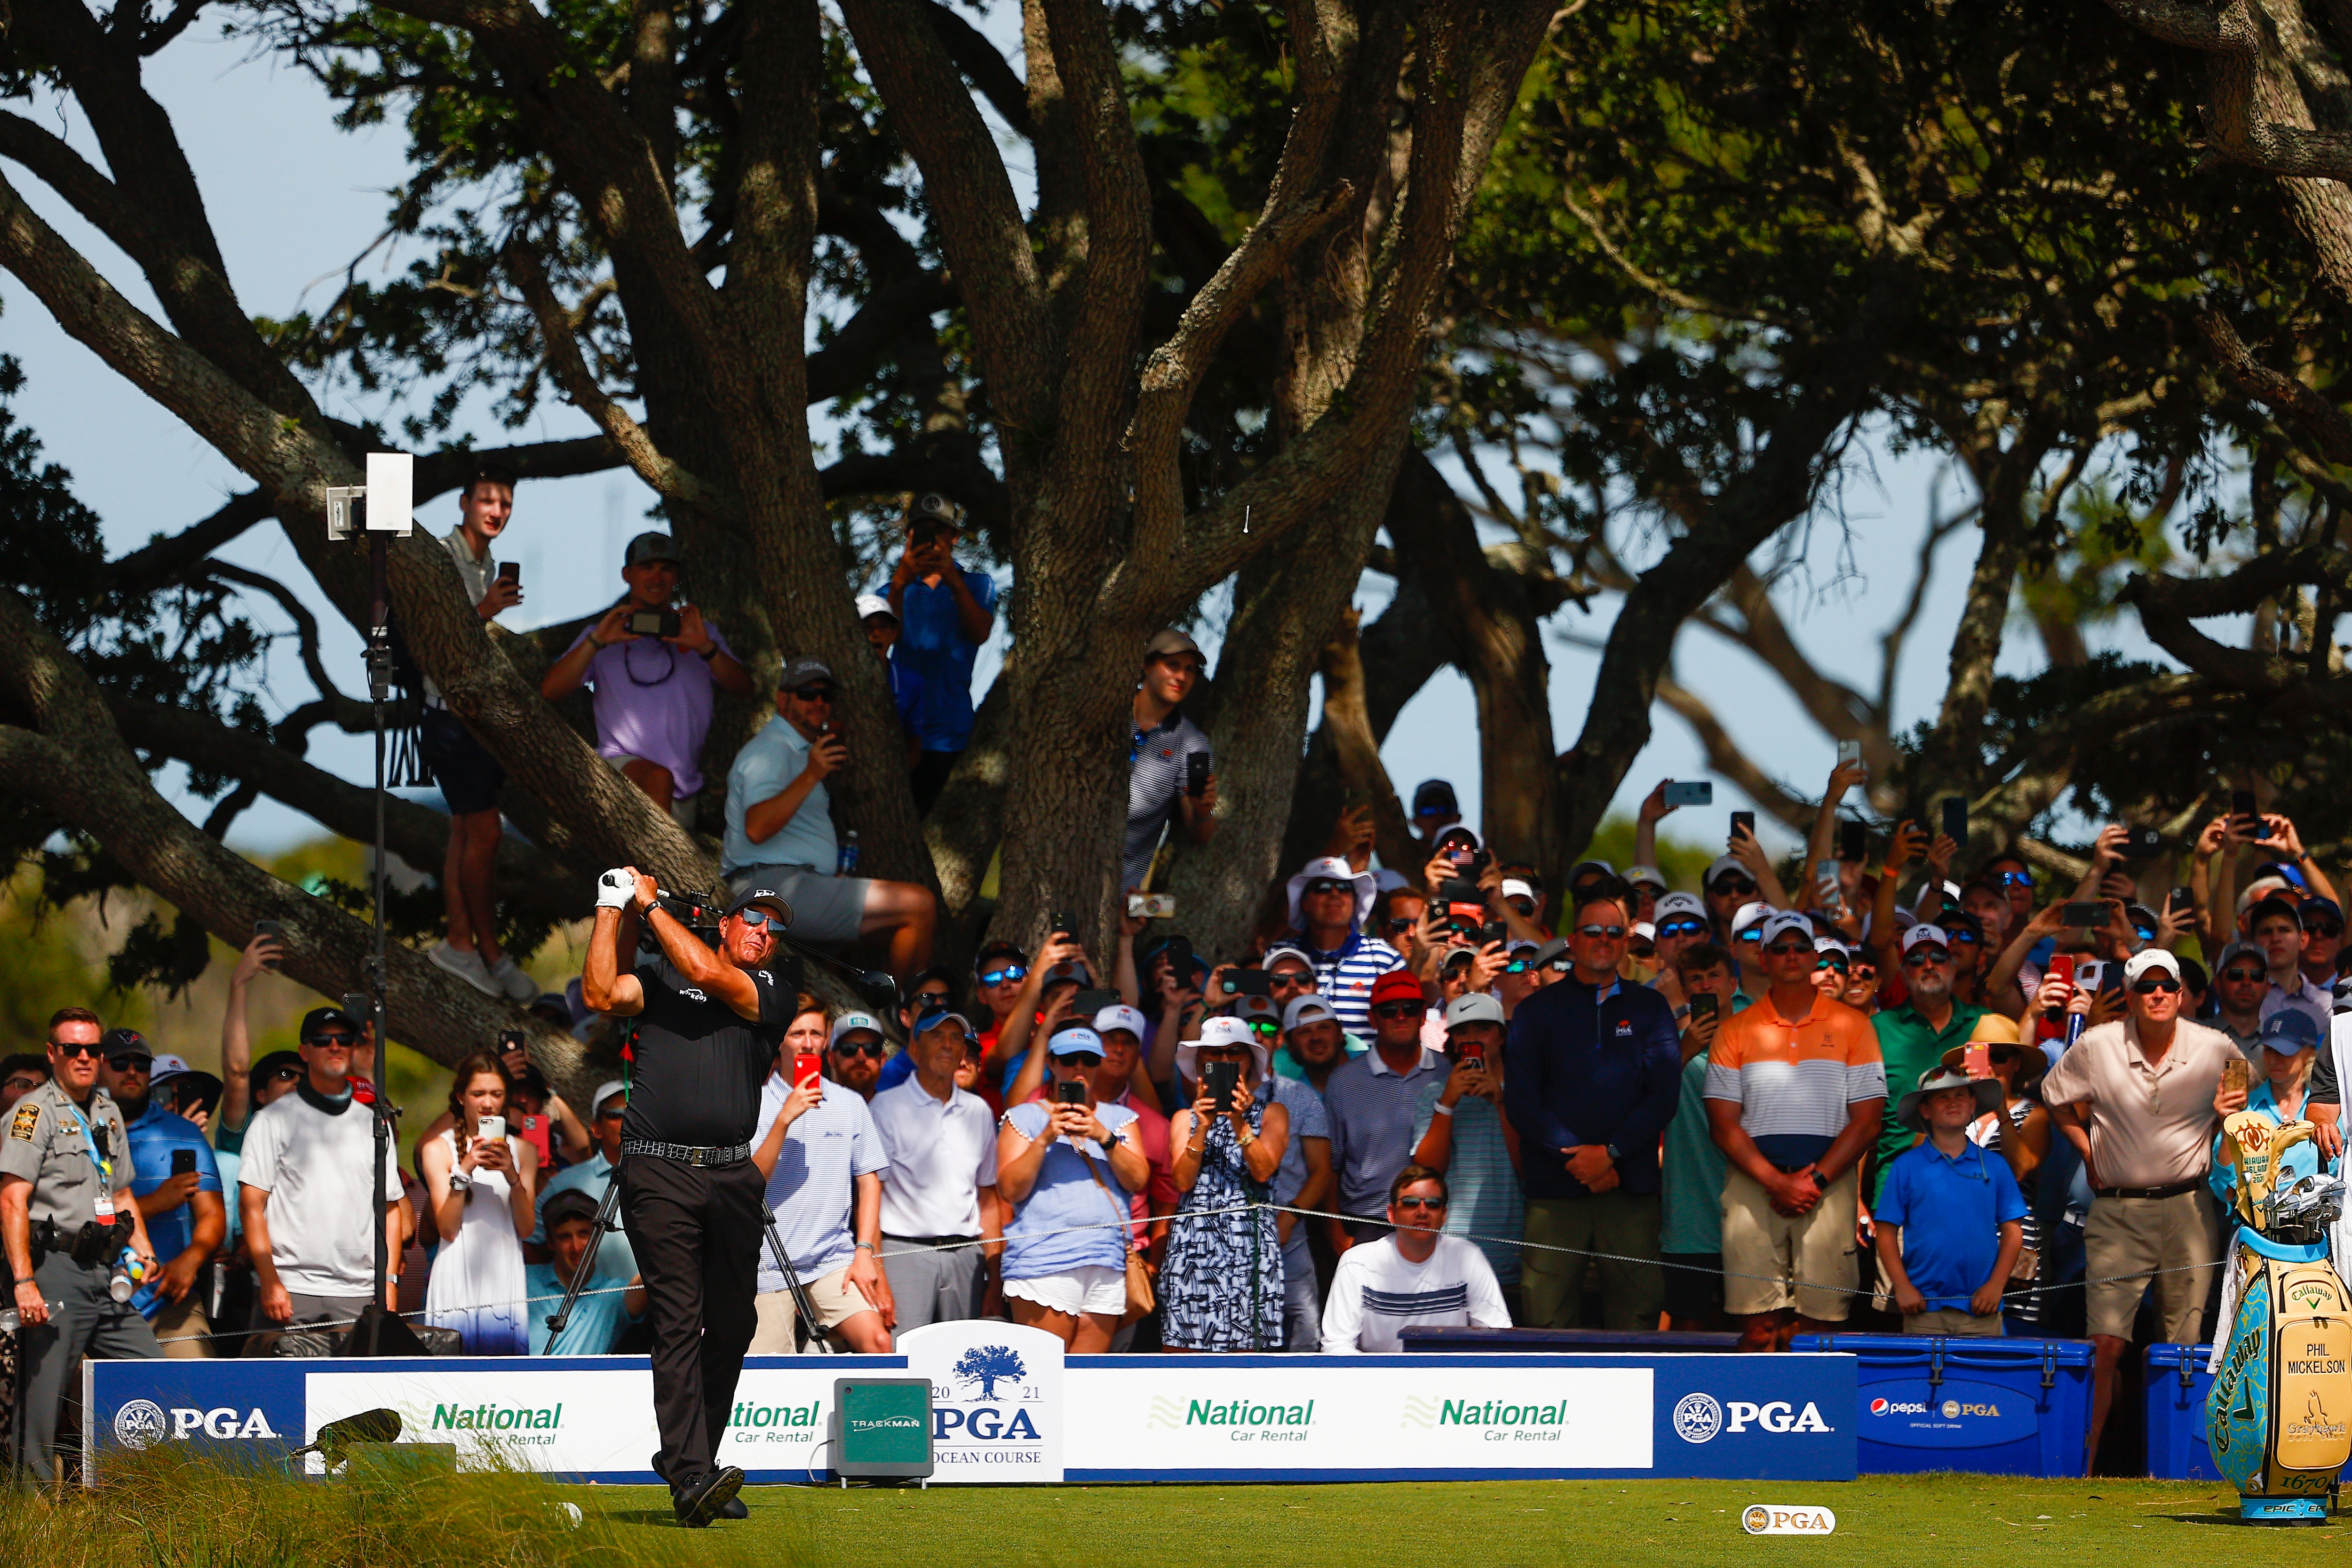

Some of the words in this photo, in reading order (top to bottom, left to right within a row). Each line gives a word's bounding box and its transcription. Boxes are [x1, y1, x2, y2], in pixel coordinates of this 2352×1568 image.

[2247, 1164, 2267, 1173] ISLAND
[2292, 1285, 2332, 1301] Callaway
[2307, 1344, 2330, 1357] PHIL
[2288, 1360, 2345, 1374] MICKELSON
[932, 1386, 950, 1398] 20
[1023, 1386, 1039, 1398] 21
[2215, 1326, 2260, 1453] Callaway
[1186, 1399, 1314, 1425] National
[1439, 1399, 1567, 1425] National
[1890, 1402, 1928, 1415] pepsi
[1962, 1404, 2000, 1417] PGA
[432, 1403, 562, 1430] National
[1684, 1413, 1713, 1423] PGA
[1726, 1401, 1830, 1433] PGA
[170, 1408, 277, 1440] PGA
[851, 1419, 921, 1428] TRACKMAN
[933, 1409, 1041, 1440] PGA
[2288, 1423, 2346, 1435] Grayhawk
[509, 1434, 556, 1445] Rental
[736, 1432, 760, 1443] Car
[765, 1431, 814, 1442] Rental
[1231, 1430, 1255, 1441] Car
[1261, 1430, 1308, 1441] Rental
[1484, 1430, 1509, 1441] Car
[1514, 1430, 1561, 1441] Rental
[933, 1452, 979, 1464] OCEAN
[985, 1451, 1041, 1464] COURSE
[2280, 1474, 2328, 1494] 1670
[1773, 1512, 1829, 1530] PGA
